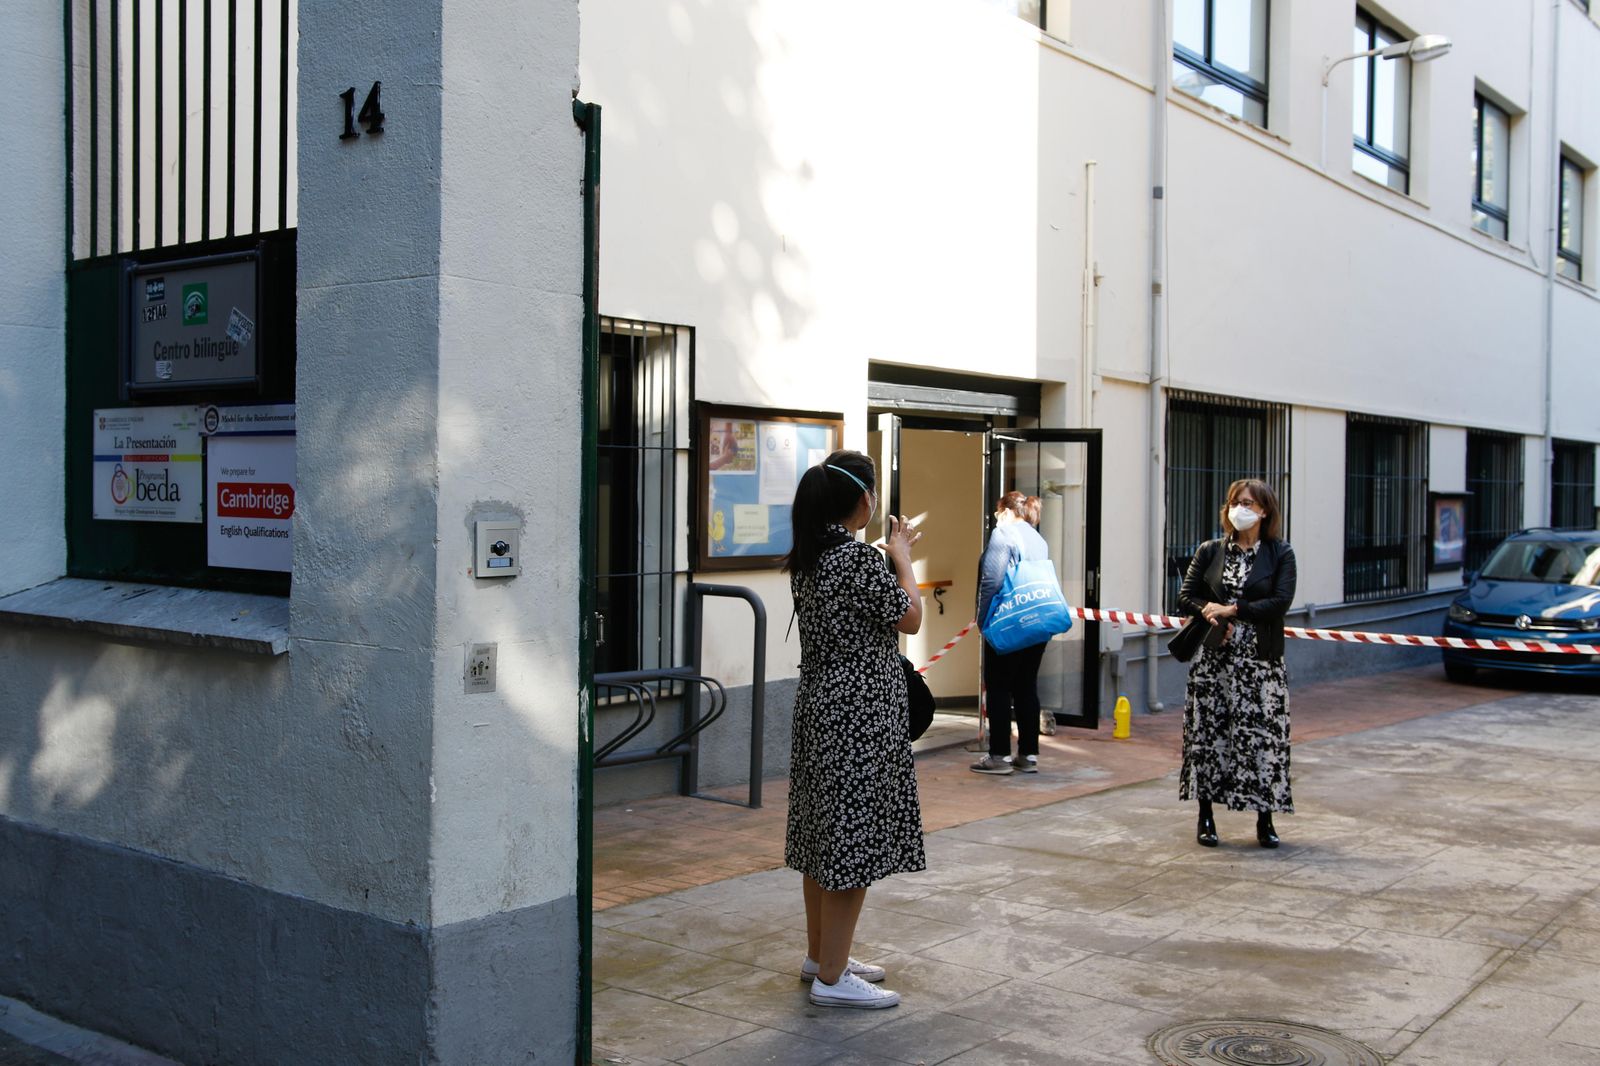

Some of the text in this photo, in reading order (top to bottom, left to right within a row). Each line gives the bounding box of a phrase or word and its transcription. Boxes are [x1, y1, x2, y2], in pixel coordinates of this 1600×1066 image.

[339, 81, 385, 139] 14
[153, 336, 239, 362] Centro bilingüe
[221, 414, 236, 423] Model
[236, 414, 244, 422] for
[245, 414, 253, 422] the
[254, 413, 289, 422] Reinforcement
[114, 435, 177, 449] La Presentación
[221, 467, 229, 476] We
[230, 468, 248, 478] prepare
[135, 468, 181, 502] beda
[220, 487, 289, 515] Cambridge
[220, 525, 289, 539] English Qualifications
